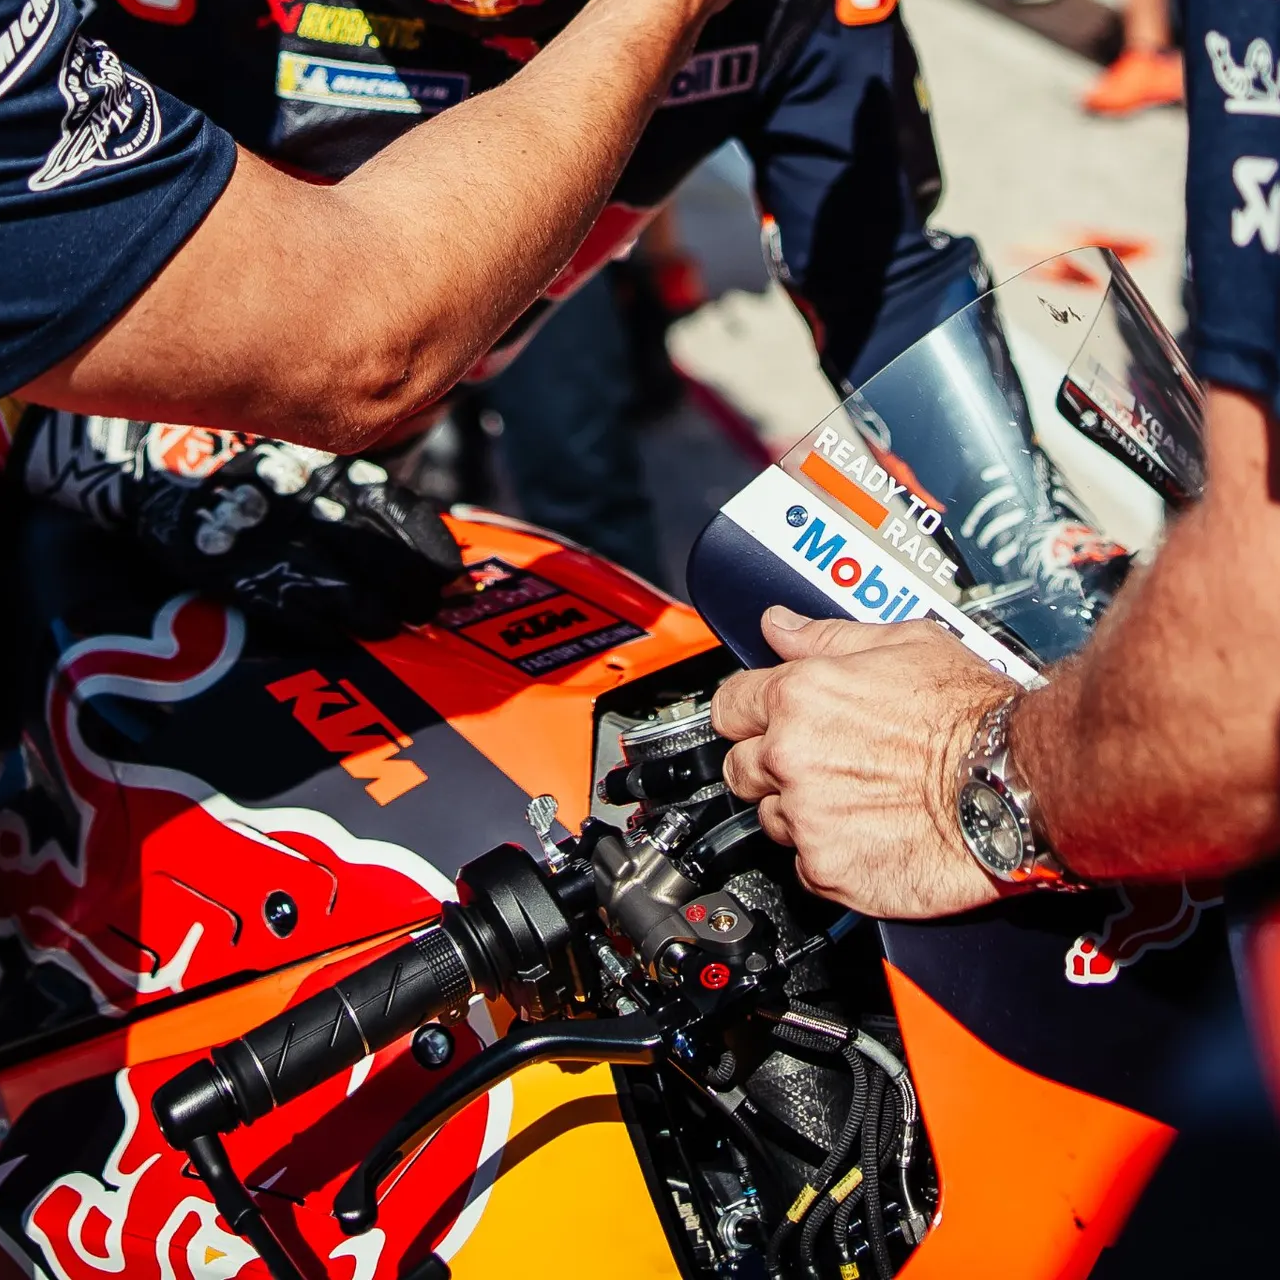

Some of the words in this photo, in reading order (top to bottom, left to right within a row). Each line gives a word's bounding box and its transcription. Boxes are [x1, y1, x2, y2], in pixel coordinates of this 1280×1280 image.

[813, 426, 907, 504] READY
[903, 493, 942, 536] TO
[792, 516, 920, 624] Mobil
[882, 517, 959, 587] RACE
[499, 607, 588, 648] KTM
[265, 670, 429, 807] KTM
